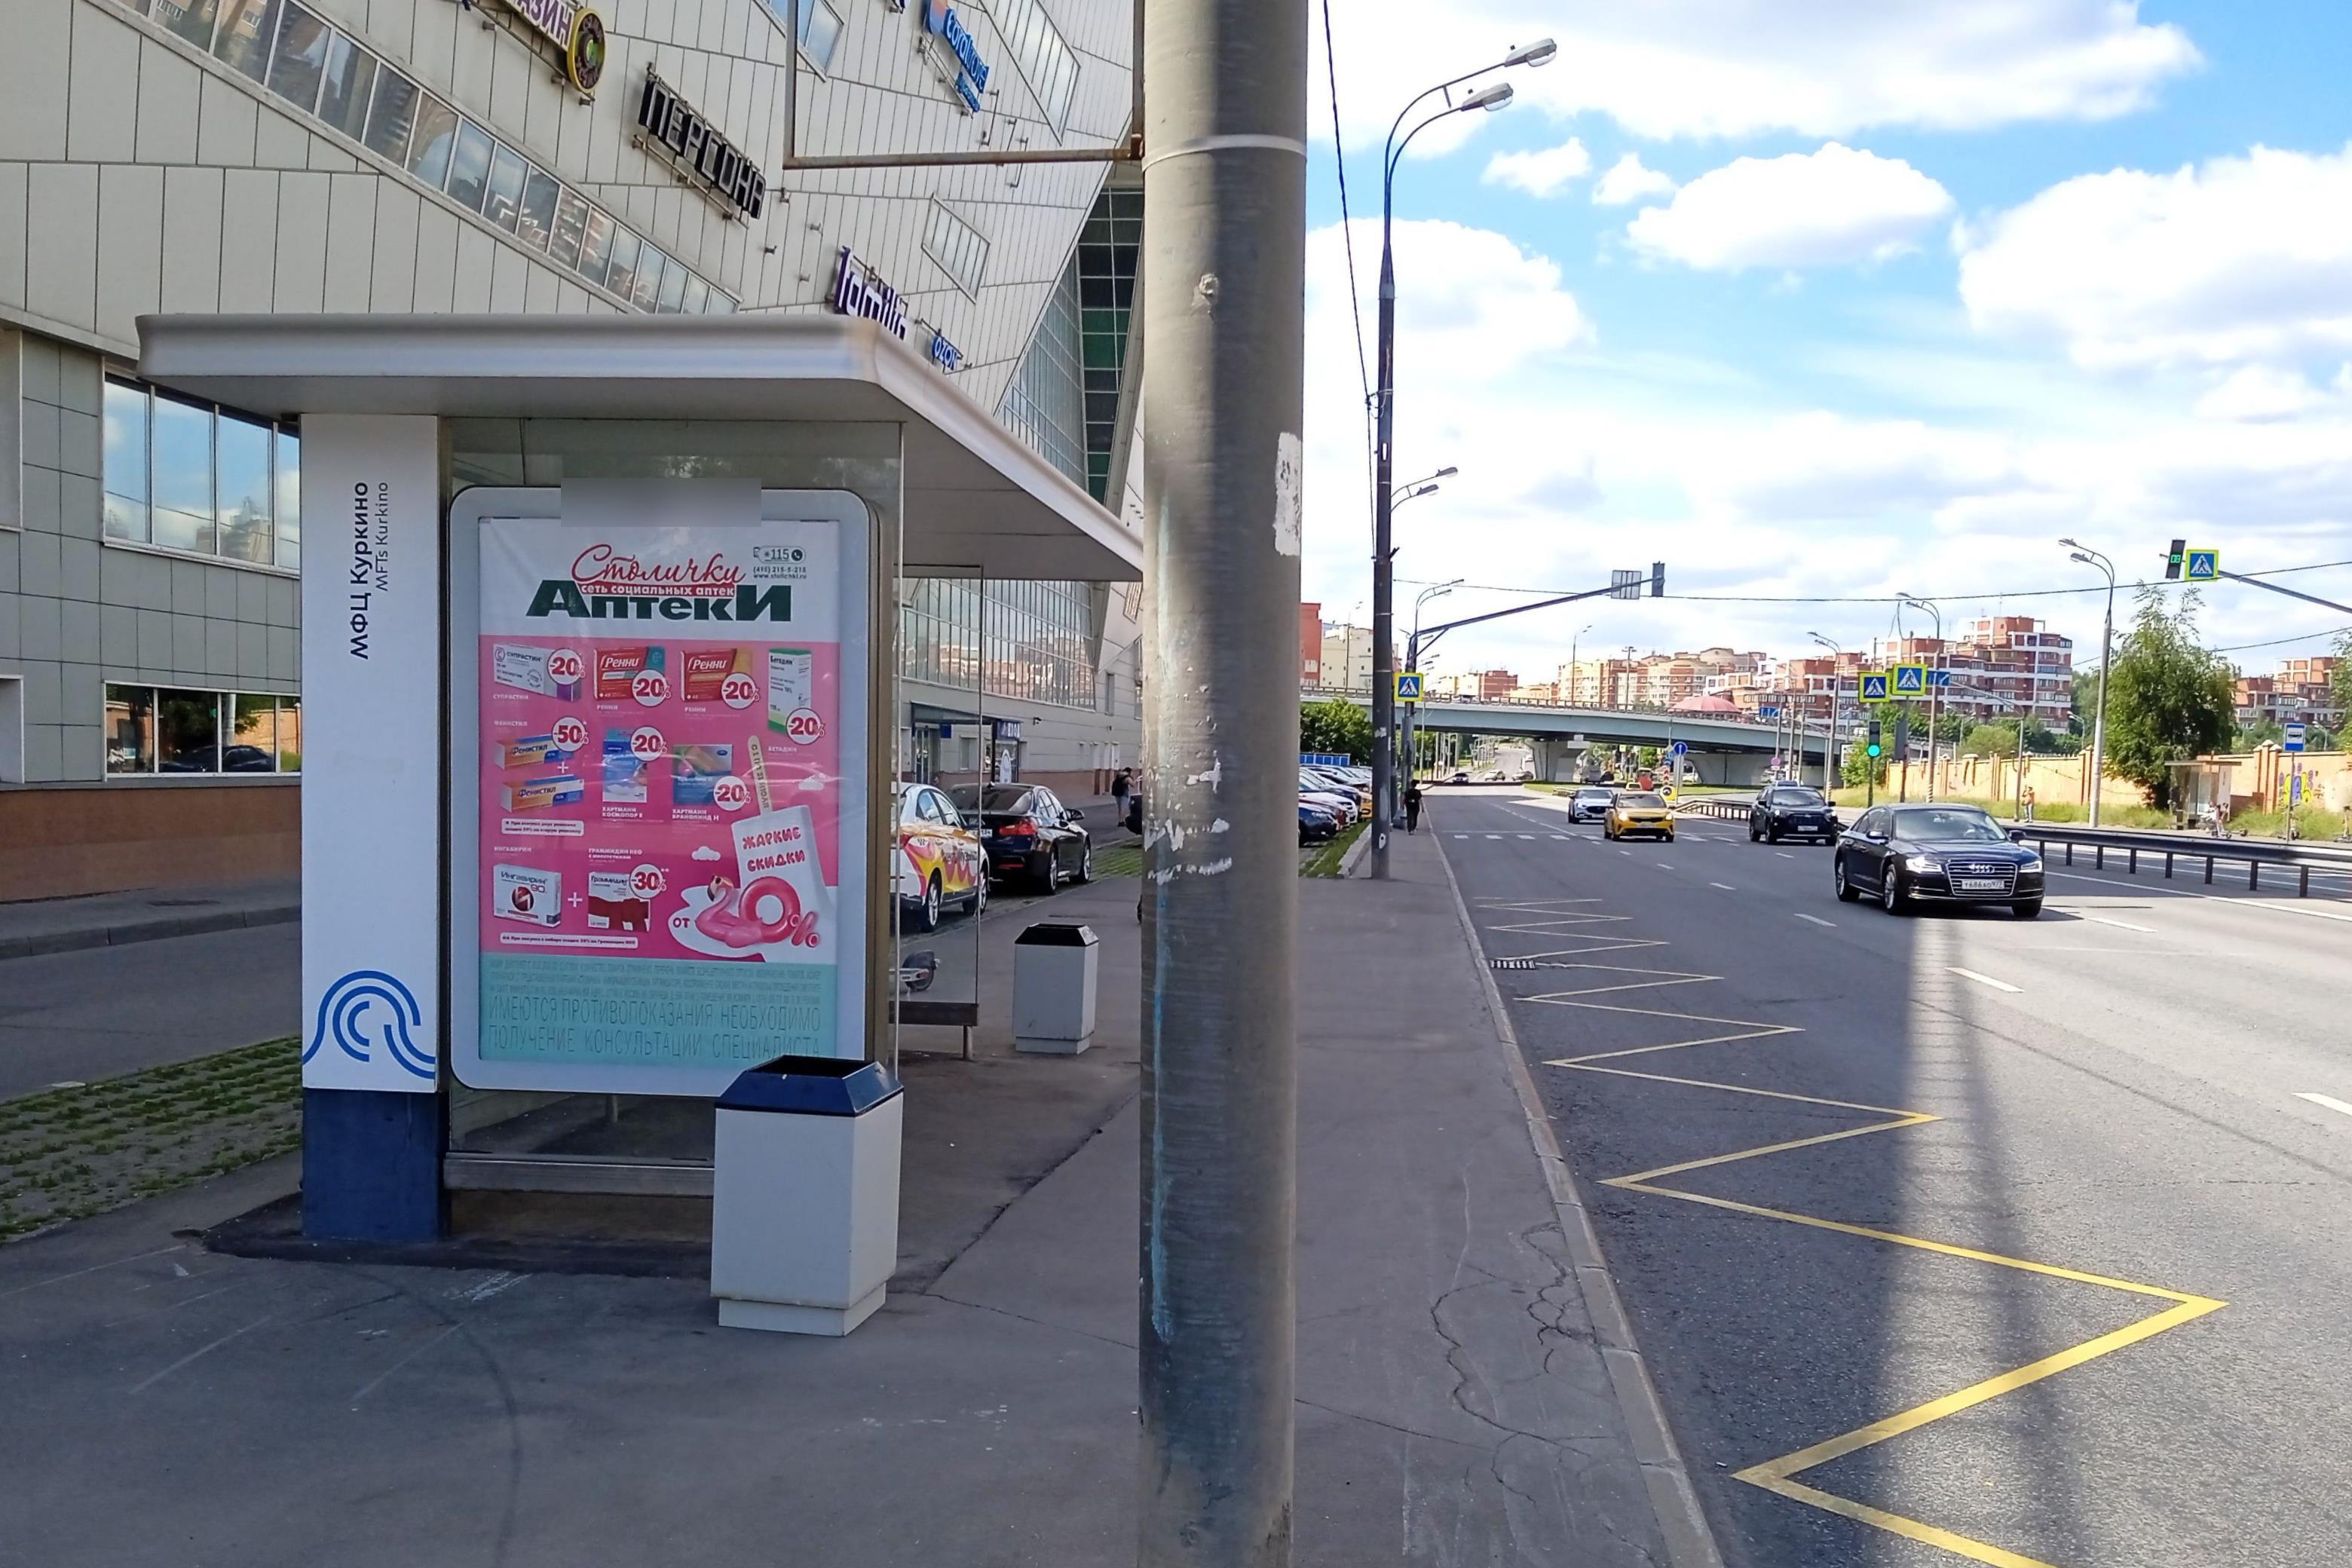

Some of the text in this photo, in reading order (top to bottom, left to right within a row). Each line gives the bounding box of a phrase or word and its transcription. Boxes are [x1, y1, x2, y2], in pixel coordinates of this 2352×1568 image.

[641, 80, 766, 219] ПЕРСОНА
[375, 482, 388, 592] MFTs Kurkino
[350, 482, 372, 660] МФЦ Куркино
[571, 543, 746, 583] Столички
[580, 584, 734, 598] сеть социальных аптек
[604, 656, 640, 669] Ренни
[691, 659, 727, 671] Ренни
[633, 678, 671, 700] -20%
[723, 681, 761, 702] -20%
[789, 717, 826, 737] -20%
[632, 734, 668, 753] -20%
[715, 783, 751, 804] -20%
[742, 826, 801, 850] ЖАРКИЕ
[746, 850, 806, 872] СКИДКИ
[489, 995, 556, 1021] ИМЕЮТСЯ
[721, 1004, 821, 1031] НЕОБХОДИМО
[489, 1024, 575, 1052] ПОЛУЧЕНИЕ
[585, 1028, 702, 1057] КОНСУЛЬТАЦИИ
